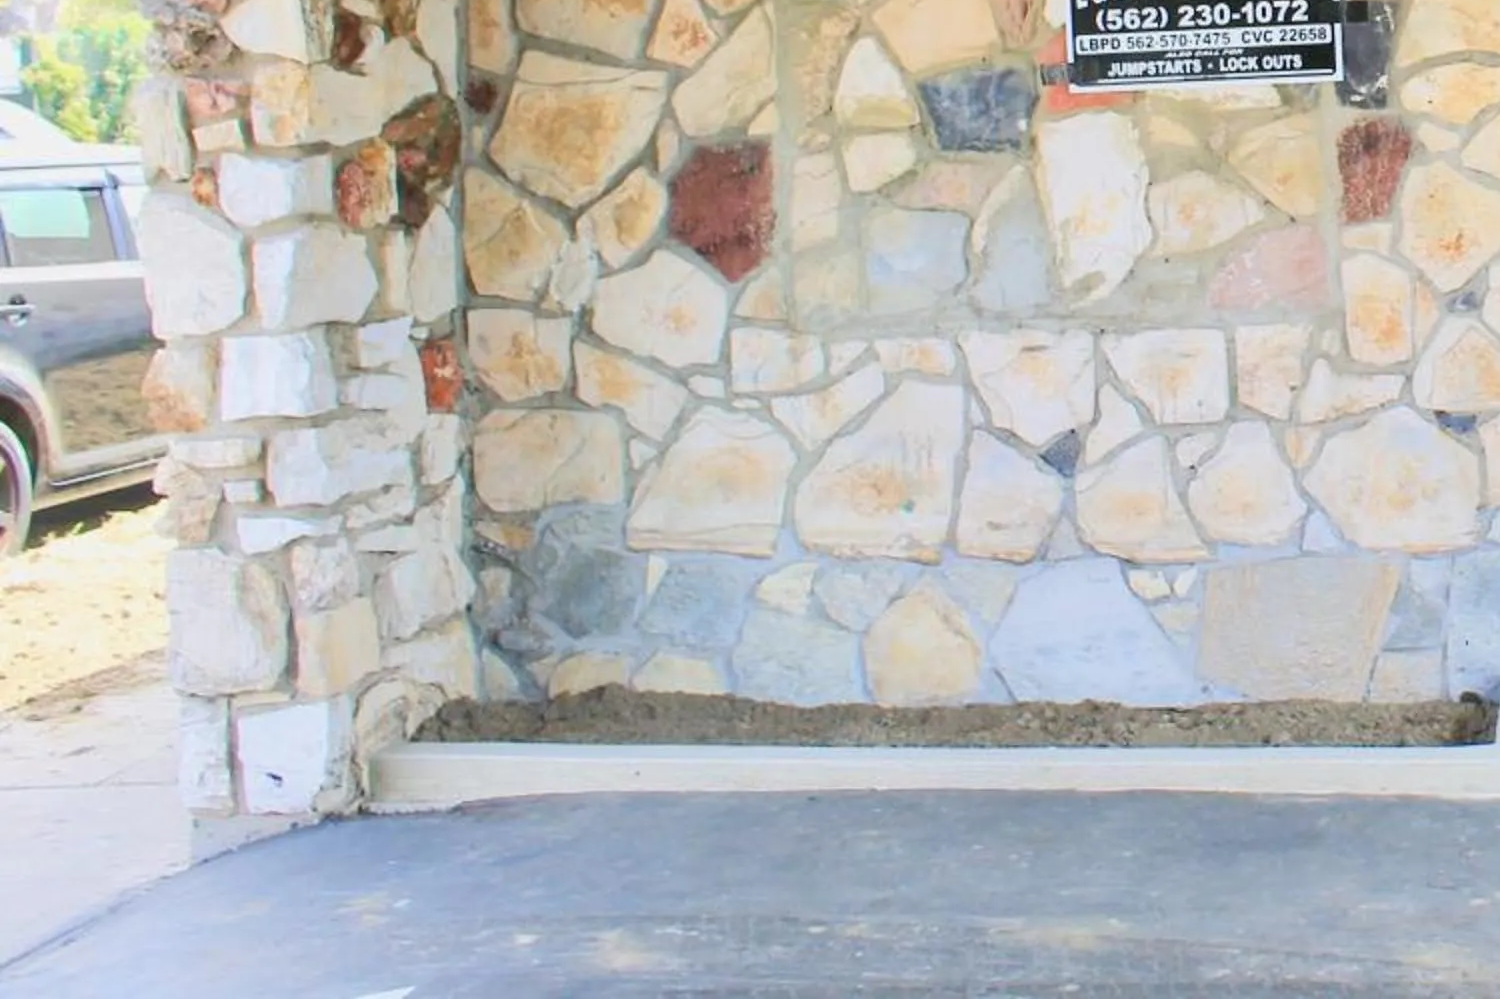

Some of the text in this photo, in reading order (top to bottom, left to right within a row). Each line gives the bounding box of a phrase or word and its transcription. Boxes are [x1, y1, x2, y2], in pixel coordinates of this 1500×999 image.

[1095, 5, 1169, 31] (562)
[1080, 38, 1121, 52] LBPD
[1241, 30, 1273, 44] CVC
[1279, 27, 1327, 42] 22658
[1107, 53, 1304, 78] JUMPSTARTS LOCK OUTS
